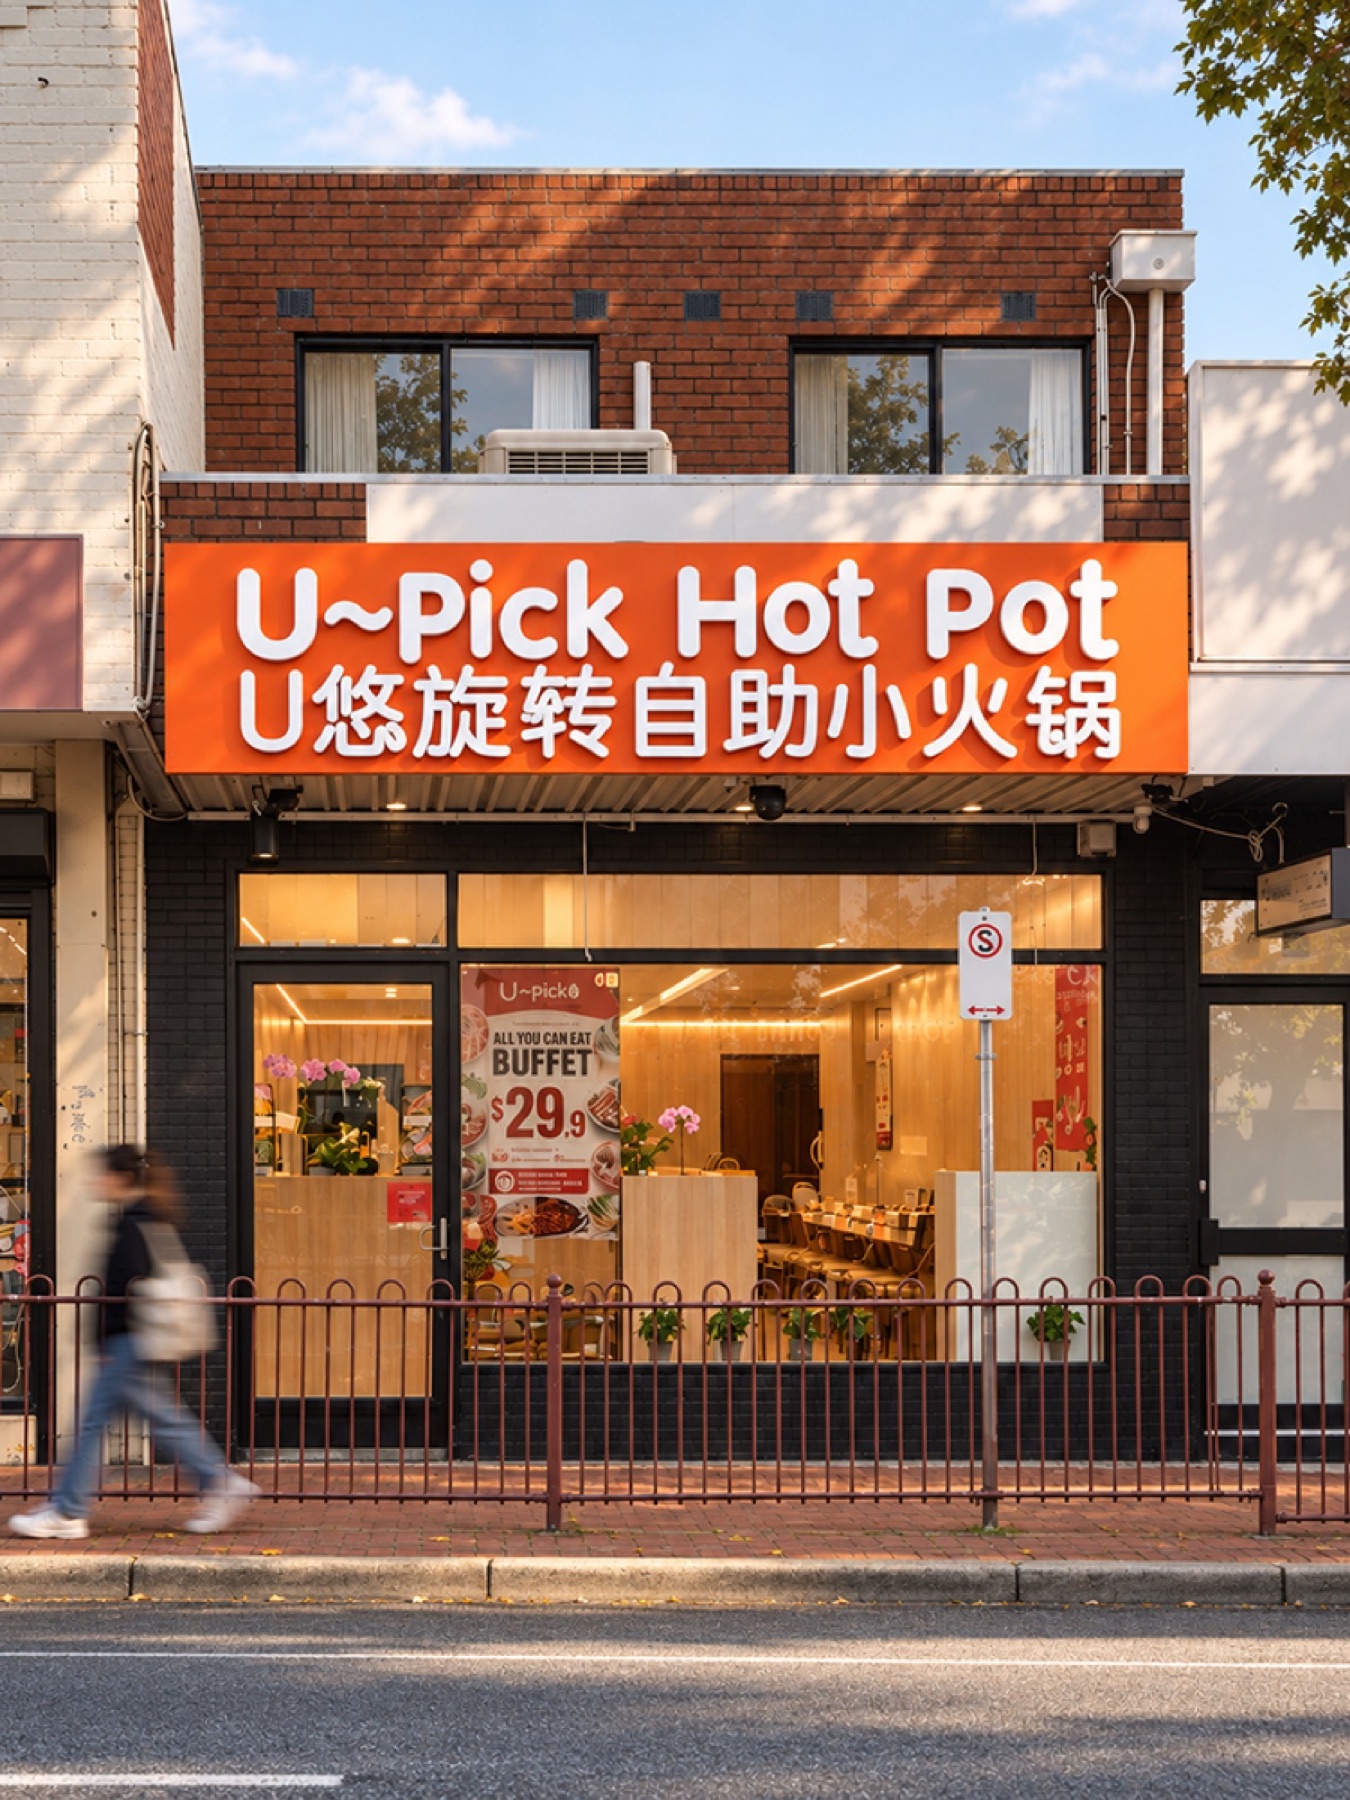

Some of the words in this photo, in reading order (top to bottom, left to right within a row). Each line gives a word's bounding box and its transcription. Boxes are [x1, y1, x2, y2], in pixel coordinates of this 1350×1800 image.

[236, 559, 629, 664] U~Pick
[677, 558, 879, 658] Hot
[926, 558, 1120, 660] Pot
[493, 1031, 515, 1045] ALL
[516, 1031, 541, 1045] YOU
[542, 1031, 568, 1045] CAN
[569, 1031, 592, 1045] EAT
[493, 1049, 593, 1077] BUFFET
